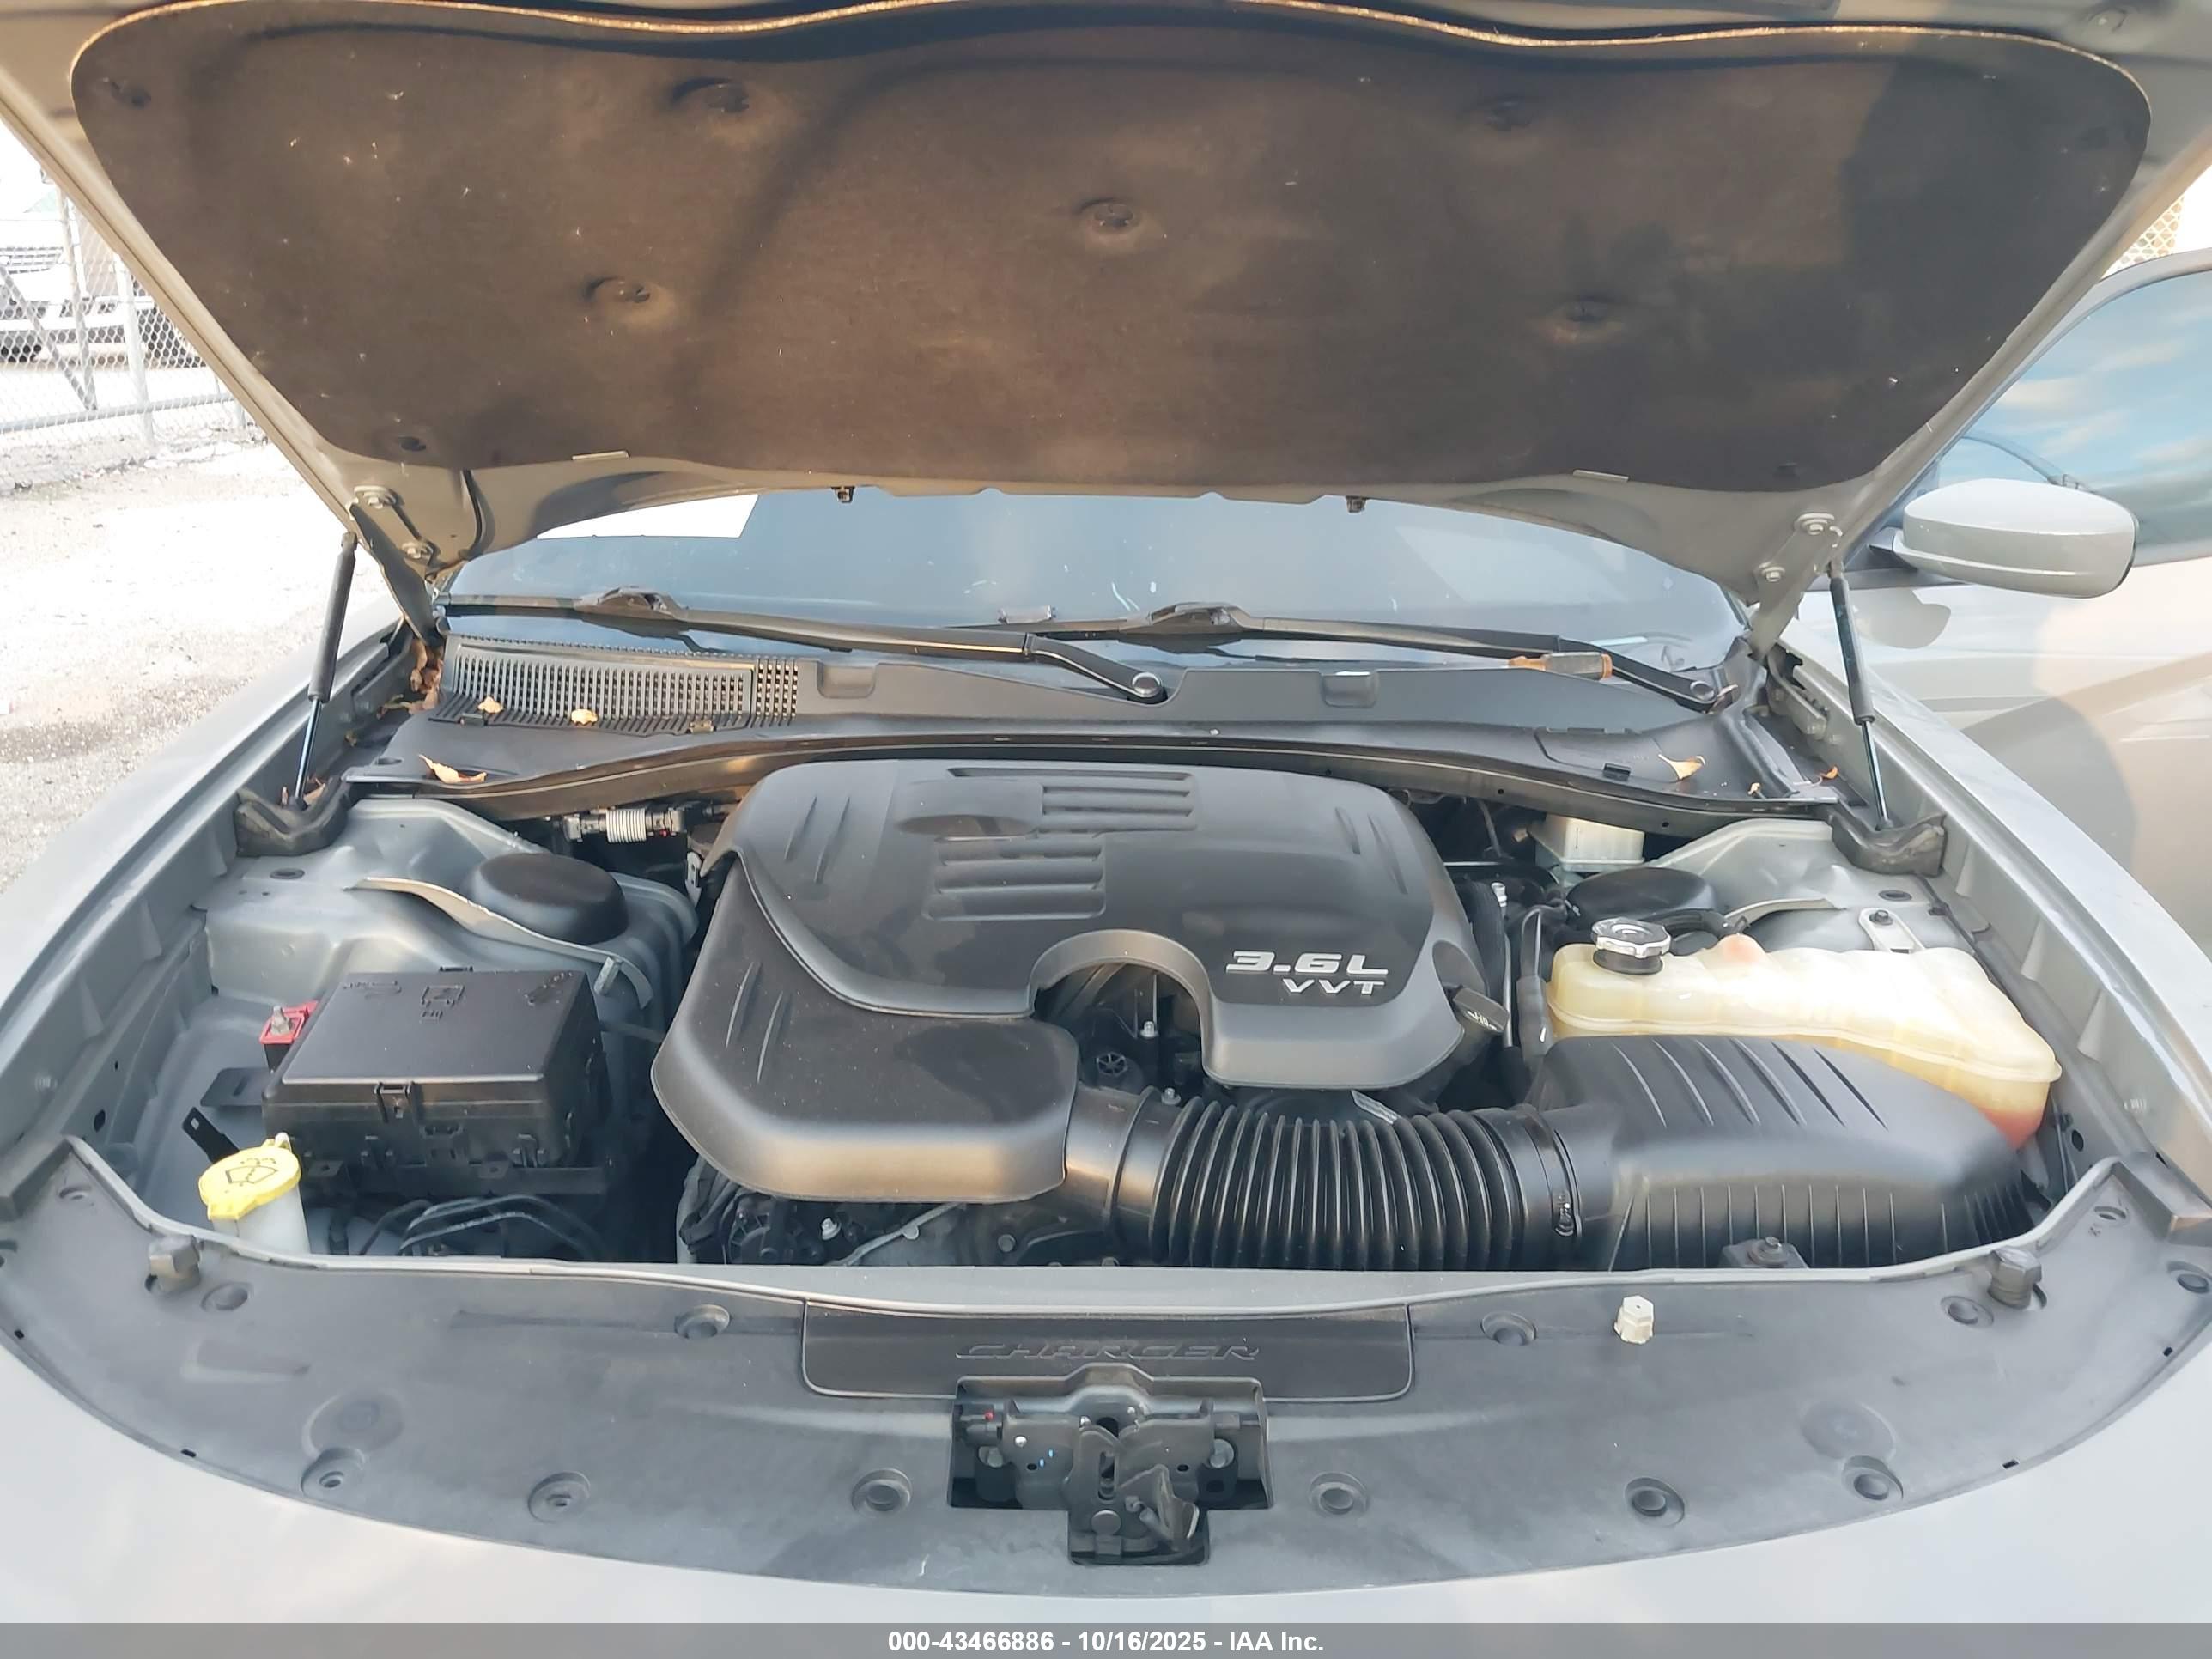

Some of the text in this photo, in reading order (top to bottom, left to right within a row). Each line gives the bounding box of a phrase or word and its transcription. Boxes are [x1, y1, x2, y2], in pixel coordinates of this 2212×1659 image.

[1225, 950, 1389, 975] 3.6L
[1282, 978, 1385, 995] VVT
[955, 1340, 1260, 1360] CHARGER
